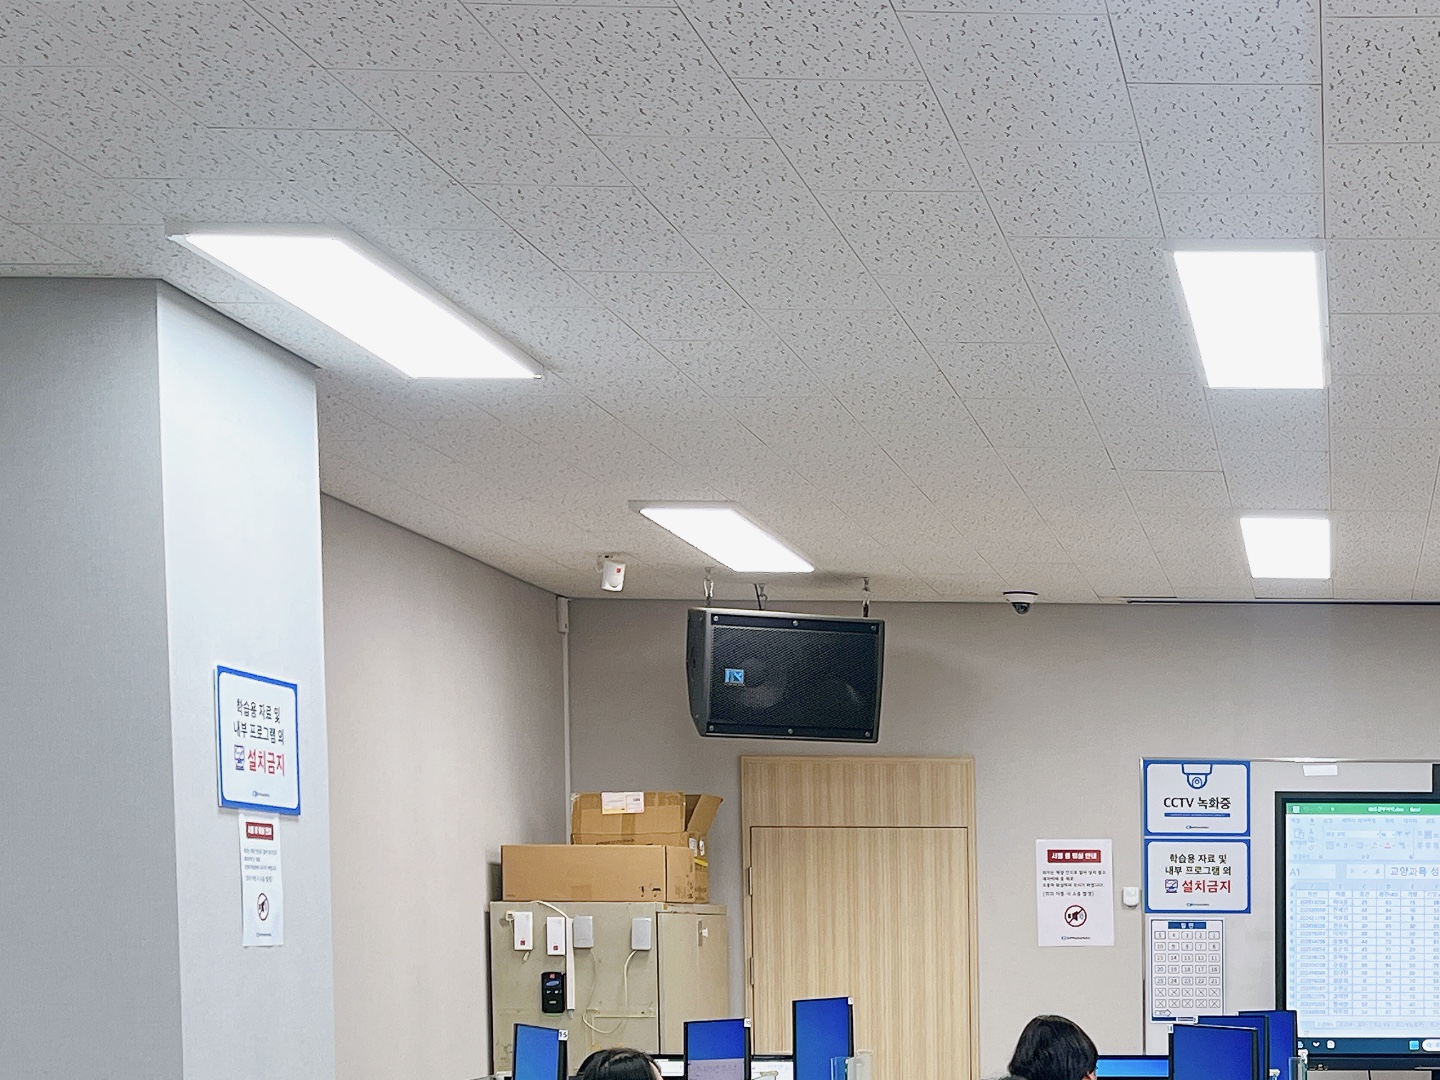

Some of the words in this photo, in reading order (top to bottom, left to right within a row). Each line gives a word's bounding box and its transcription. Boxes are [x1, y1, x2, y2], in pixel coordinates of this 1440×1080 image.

[259, 704, 272, 720] 자료
[274, 706, 280, 724] 및
[233, 721, 248, 738] 내부
[250, 724, 276, 744] 프로그램
[278, 729, 284, 745] 외
[248, 749, 285, 776] 설치금지
[1163, 797, 1194, 808] CCTV
[1197, 797, 1231, 809] 녹화중
[1170, 854, 1195, 864] 학습용
[1198, 854, 1216, 864] 자료
[1218, 854, 1227, 864] 및
[1165, 866, 1182, 875] 내부
[1185, 866, 1220, 875] 프로그램
[1222, 866, 1231, 876] 외
[1182, 880, 1231, 893] 설치금지
